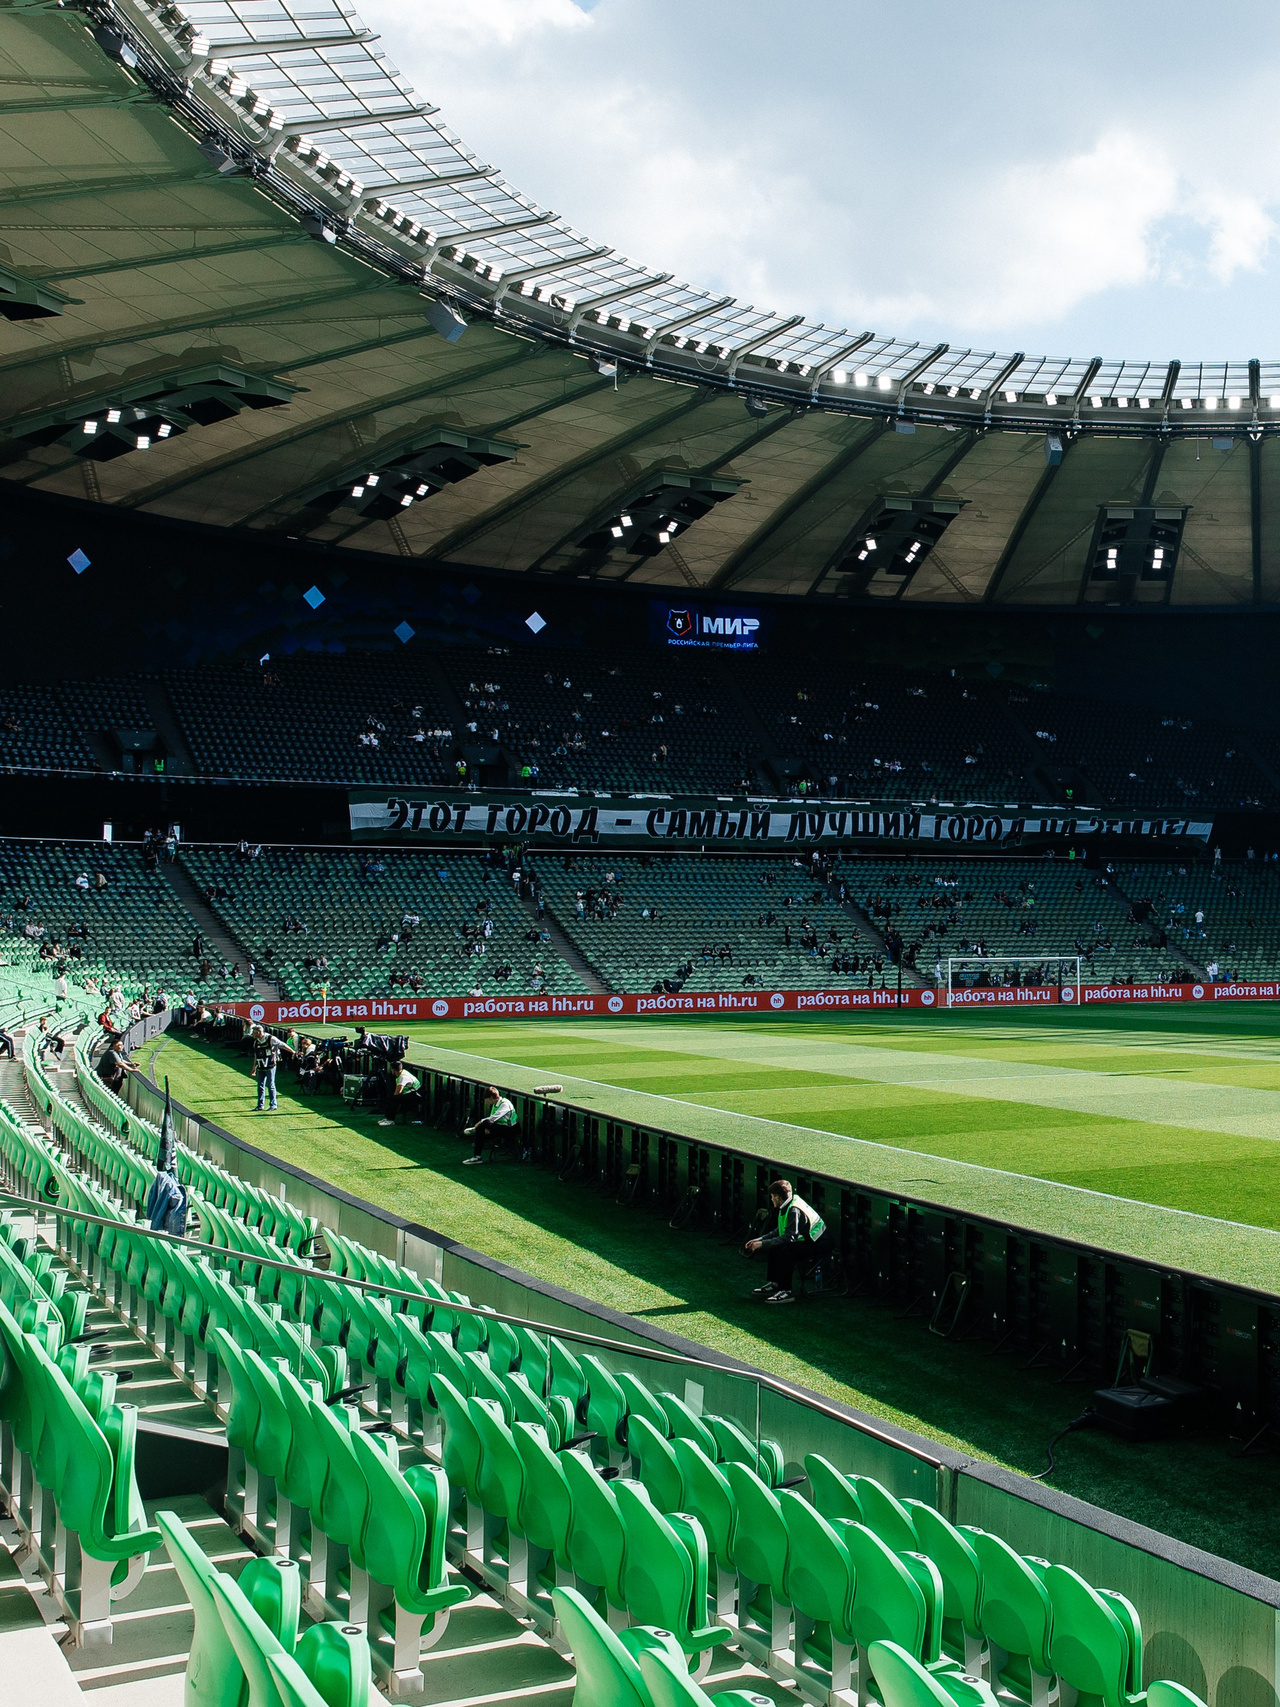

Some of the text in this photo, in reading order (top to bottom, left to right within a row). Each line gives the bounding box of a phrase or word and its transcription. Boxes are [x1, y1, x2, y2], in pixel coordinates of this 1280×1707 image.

[702, 616, 760, 635] МИР
[667, 638, 759, 649] РОССИЙСКАЯ ПРЕМЬЕР-ЛИГА
[383, 797, 472, 833] ЭТОТ
[485, 802, 600, 843] ГОРОД
[646, 803, 771, 840] САМЫЙ
[783, 806, 922, 842] ЛУЧШИЙ
[933, 812, 1027, 849] ГОРОД
[797, 991, 909, 1008] работа на hh.ru
[946, 988, 1050, 1005] работа на hh.ru
[1084, 985, 1182, 1001] работа на hh.ru
[1214, 984, 1257, 999] работа
[1259, 986, 1274, 996] на
[277, 1001, 417, 1021] работа на hh.ru
[463, 997, 594, 1016] работа на hh.ru
[636, 994, 757, 1012] работа на hh.ru
[256, 1058, 269, 1068] TV
